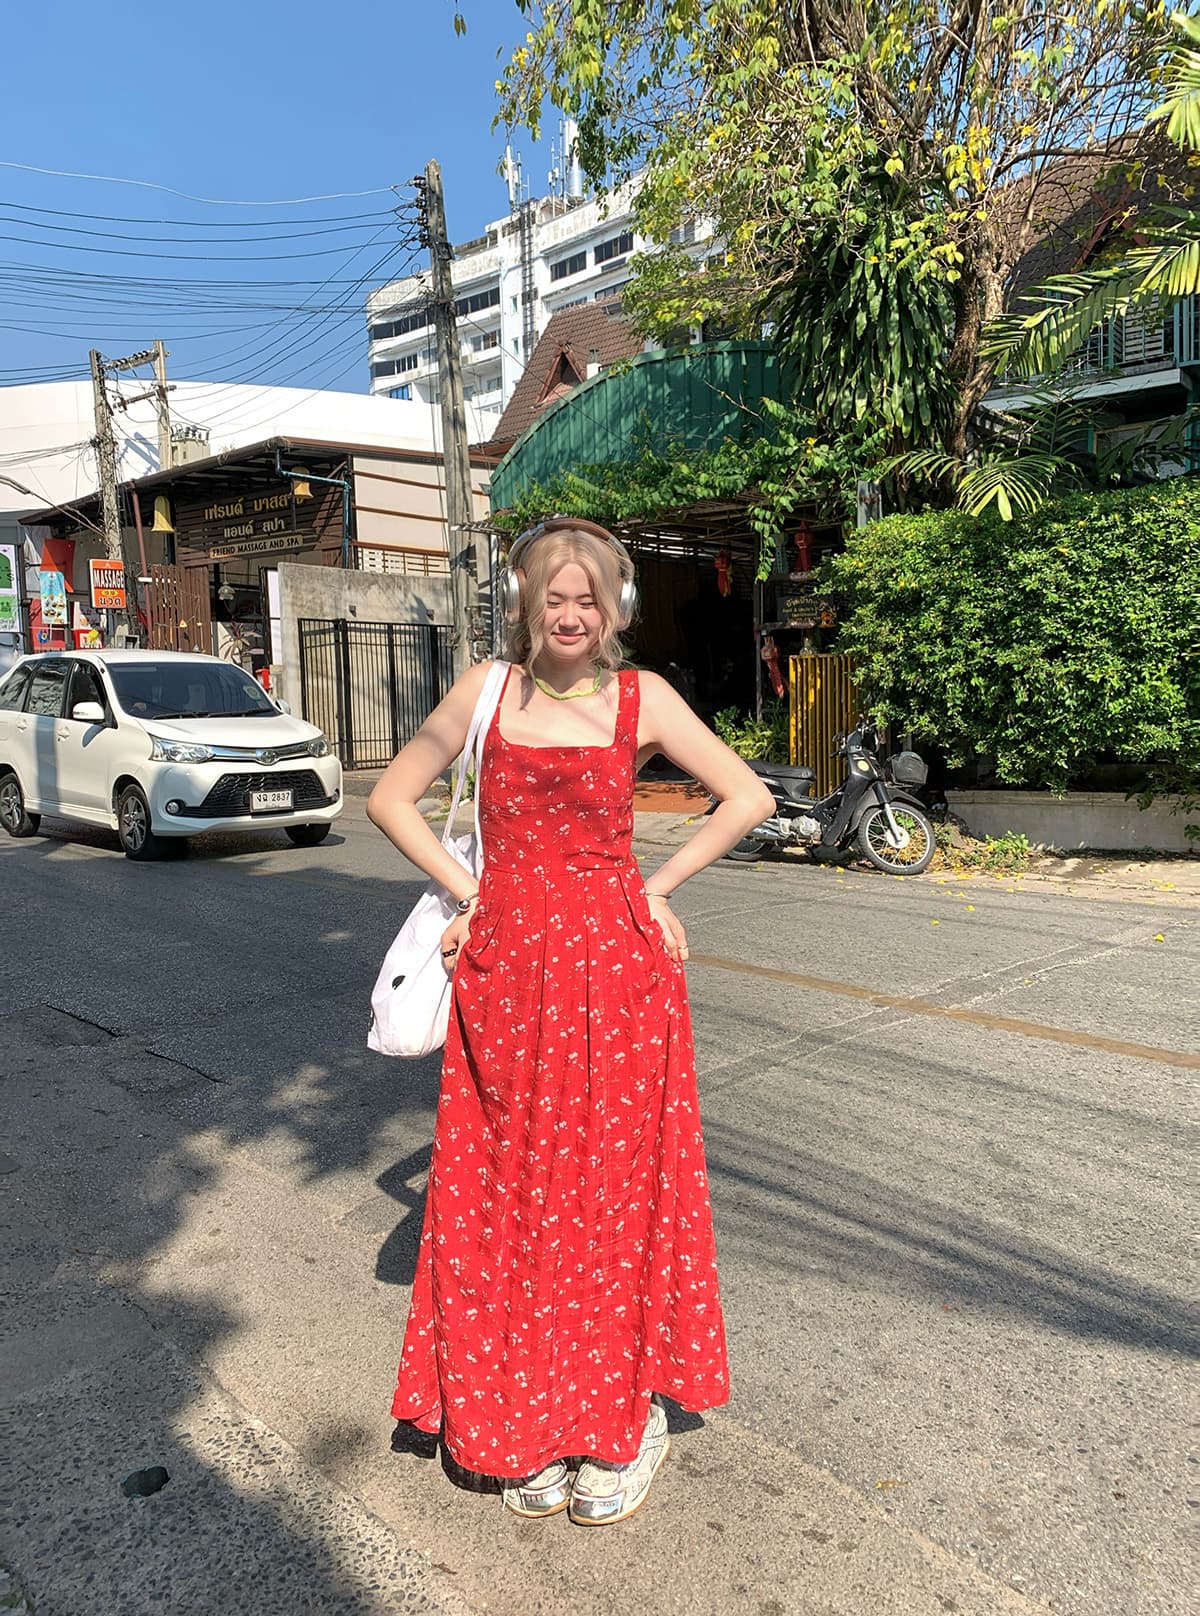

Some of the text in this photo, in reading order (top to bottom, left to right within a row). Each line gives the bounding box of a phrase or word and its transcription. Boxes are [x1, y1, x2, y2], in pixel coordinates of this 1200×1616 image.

[205, 497, 244, 520] เฟรนด์
[224, 518, 285, 538] แอนด์ สปา
[213, 537, 299, 556] FRIEND MASSAGE AND SPA
[93, 569, 125, 589] MASSAGE
[100, 597, 121, 605] นวด
[272, 793, 289, 801] 2837
